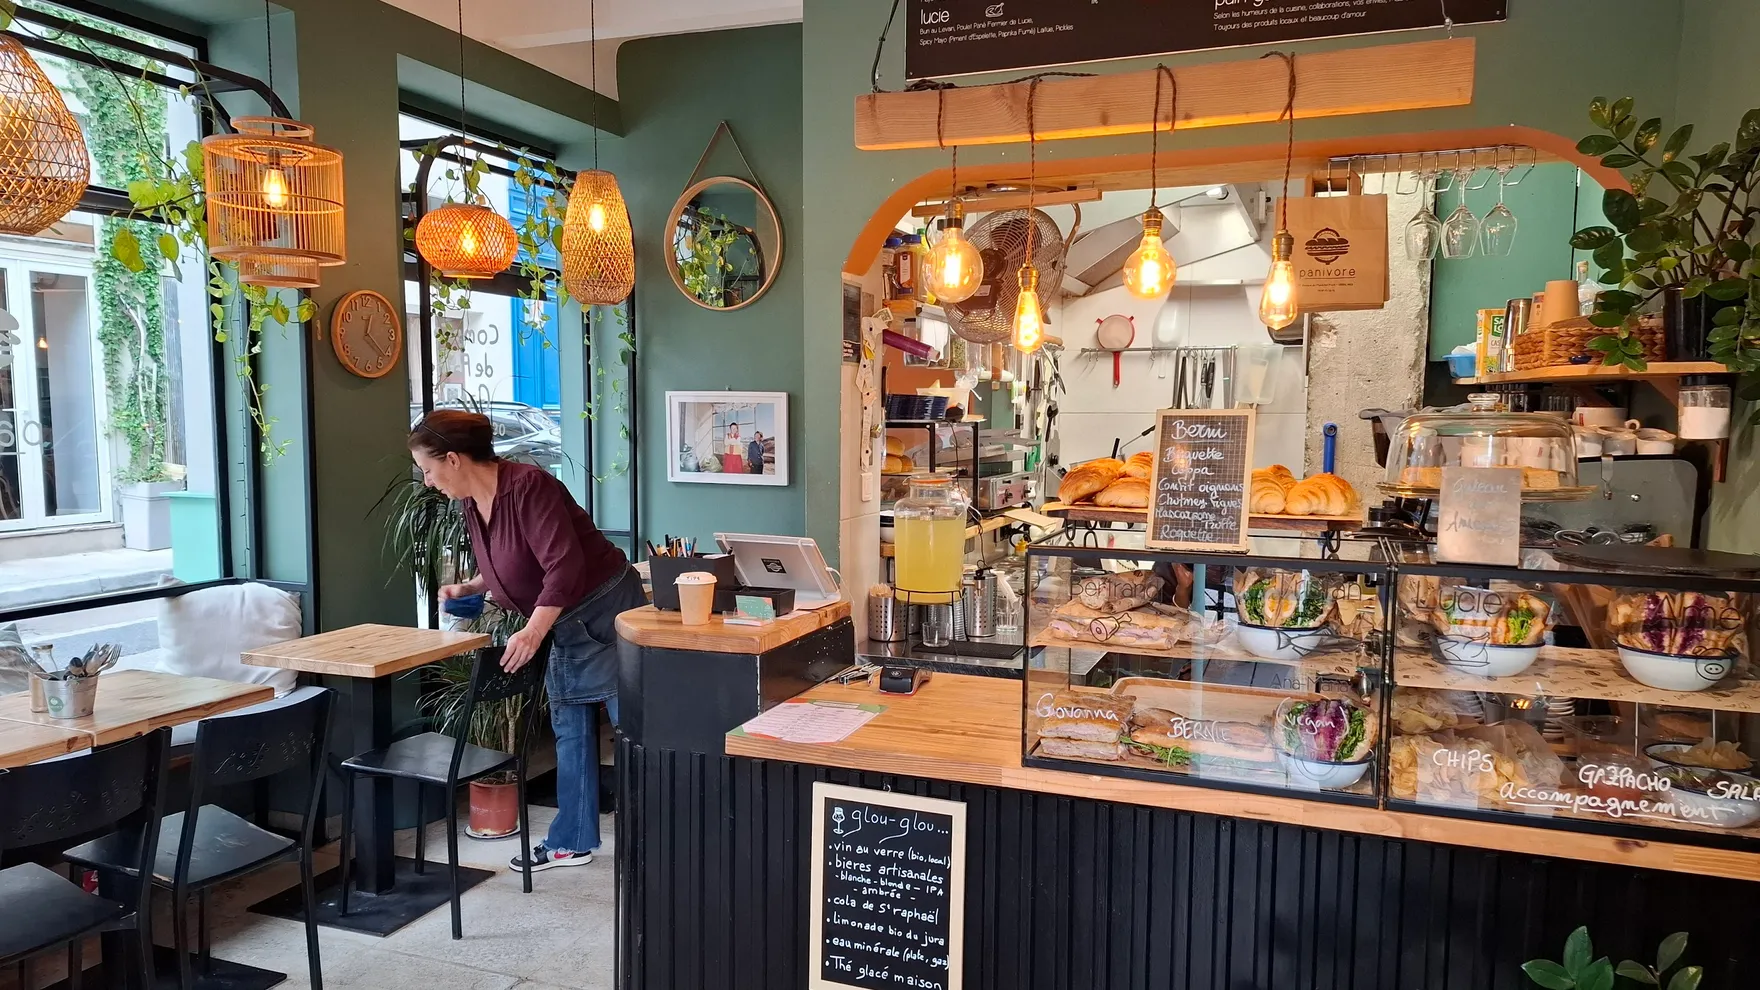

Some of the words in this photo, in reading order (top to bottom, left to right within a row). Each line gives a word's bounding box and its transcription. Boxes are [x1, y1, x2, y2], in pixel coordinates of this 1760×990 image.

[920, 8, 950, 25] lucie
[1213, 12, 1231, 20] Selon
[1241, 9, 1268, 17] humeurs
[1213, 23, 1240, 32] Toujours
[1241, 21, 1253, 29] des
[1253, 19, 1278, 29] produits
[1279, 17, 1299, 25] locaux
[1308, 13, 1340, 22] beaucoup
[1299, 268, 1356, 279] panivore
[350, 299, 359, 311] 11
[360, 295, 371, 307] 12
[341, 311, 352, 323] 10
[383, 312, 391, 324] 2
[387, 328, 396, 341] 3
[384, 344, 392, 357] 4
[353, 356, 361, 368] 7
[364, 360, 372, 372] 6
[376, 356, 384, 369] 5
[1171, 419, 1228, 440] Berni
[1162, 446, 1225, 466] Bguette
[1157, 477, 1196, 492] Confit
[1070, 574, 1163, 600] Bertrand
[1416, 580, 1503, 615] Lucie
[1650, 594, 1742, 630] Amé
[1036, 692, 1119, 721] Giovanna
[1167, 717, 1229, 743] BERNIE
[1433, 748, 1494, 772] CHIPS
[1579, 764, 1671, 791] GAZPACHO
[1500, 781, 1736, 820] accompagnement
[834, 841, 852, 851] vin
[855, 844, 869, 854] au
[873, 848, 905, 859] verre
[878, 862, 944, 885] artisanales
[861, 886, 901, 899] ambrée
[880, 877, 911, 890] blonde
[926, 885, 944, 897] IPA
[833, 894, 857, 908] cola
[862, 900, 874, 911] de
[893, 907, 939, 925] raphaël
[833, 911, 884, 933] limonade
[888, 925, 903, 937] bio
[906, 930, 919, 940] du
[921, 931, 945, 947] jura
[832, 937, 852, 949] eau
[853, 942, 900, 958] minérale
[829, 955, 853, 972] Thé
[855, 964, 889, 980] glacé
[893, 974, 942, 990] maison
